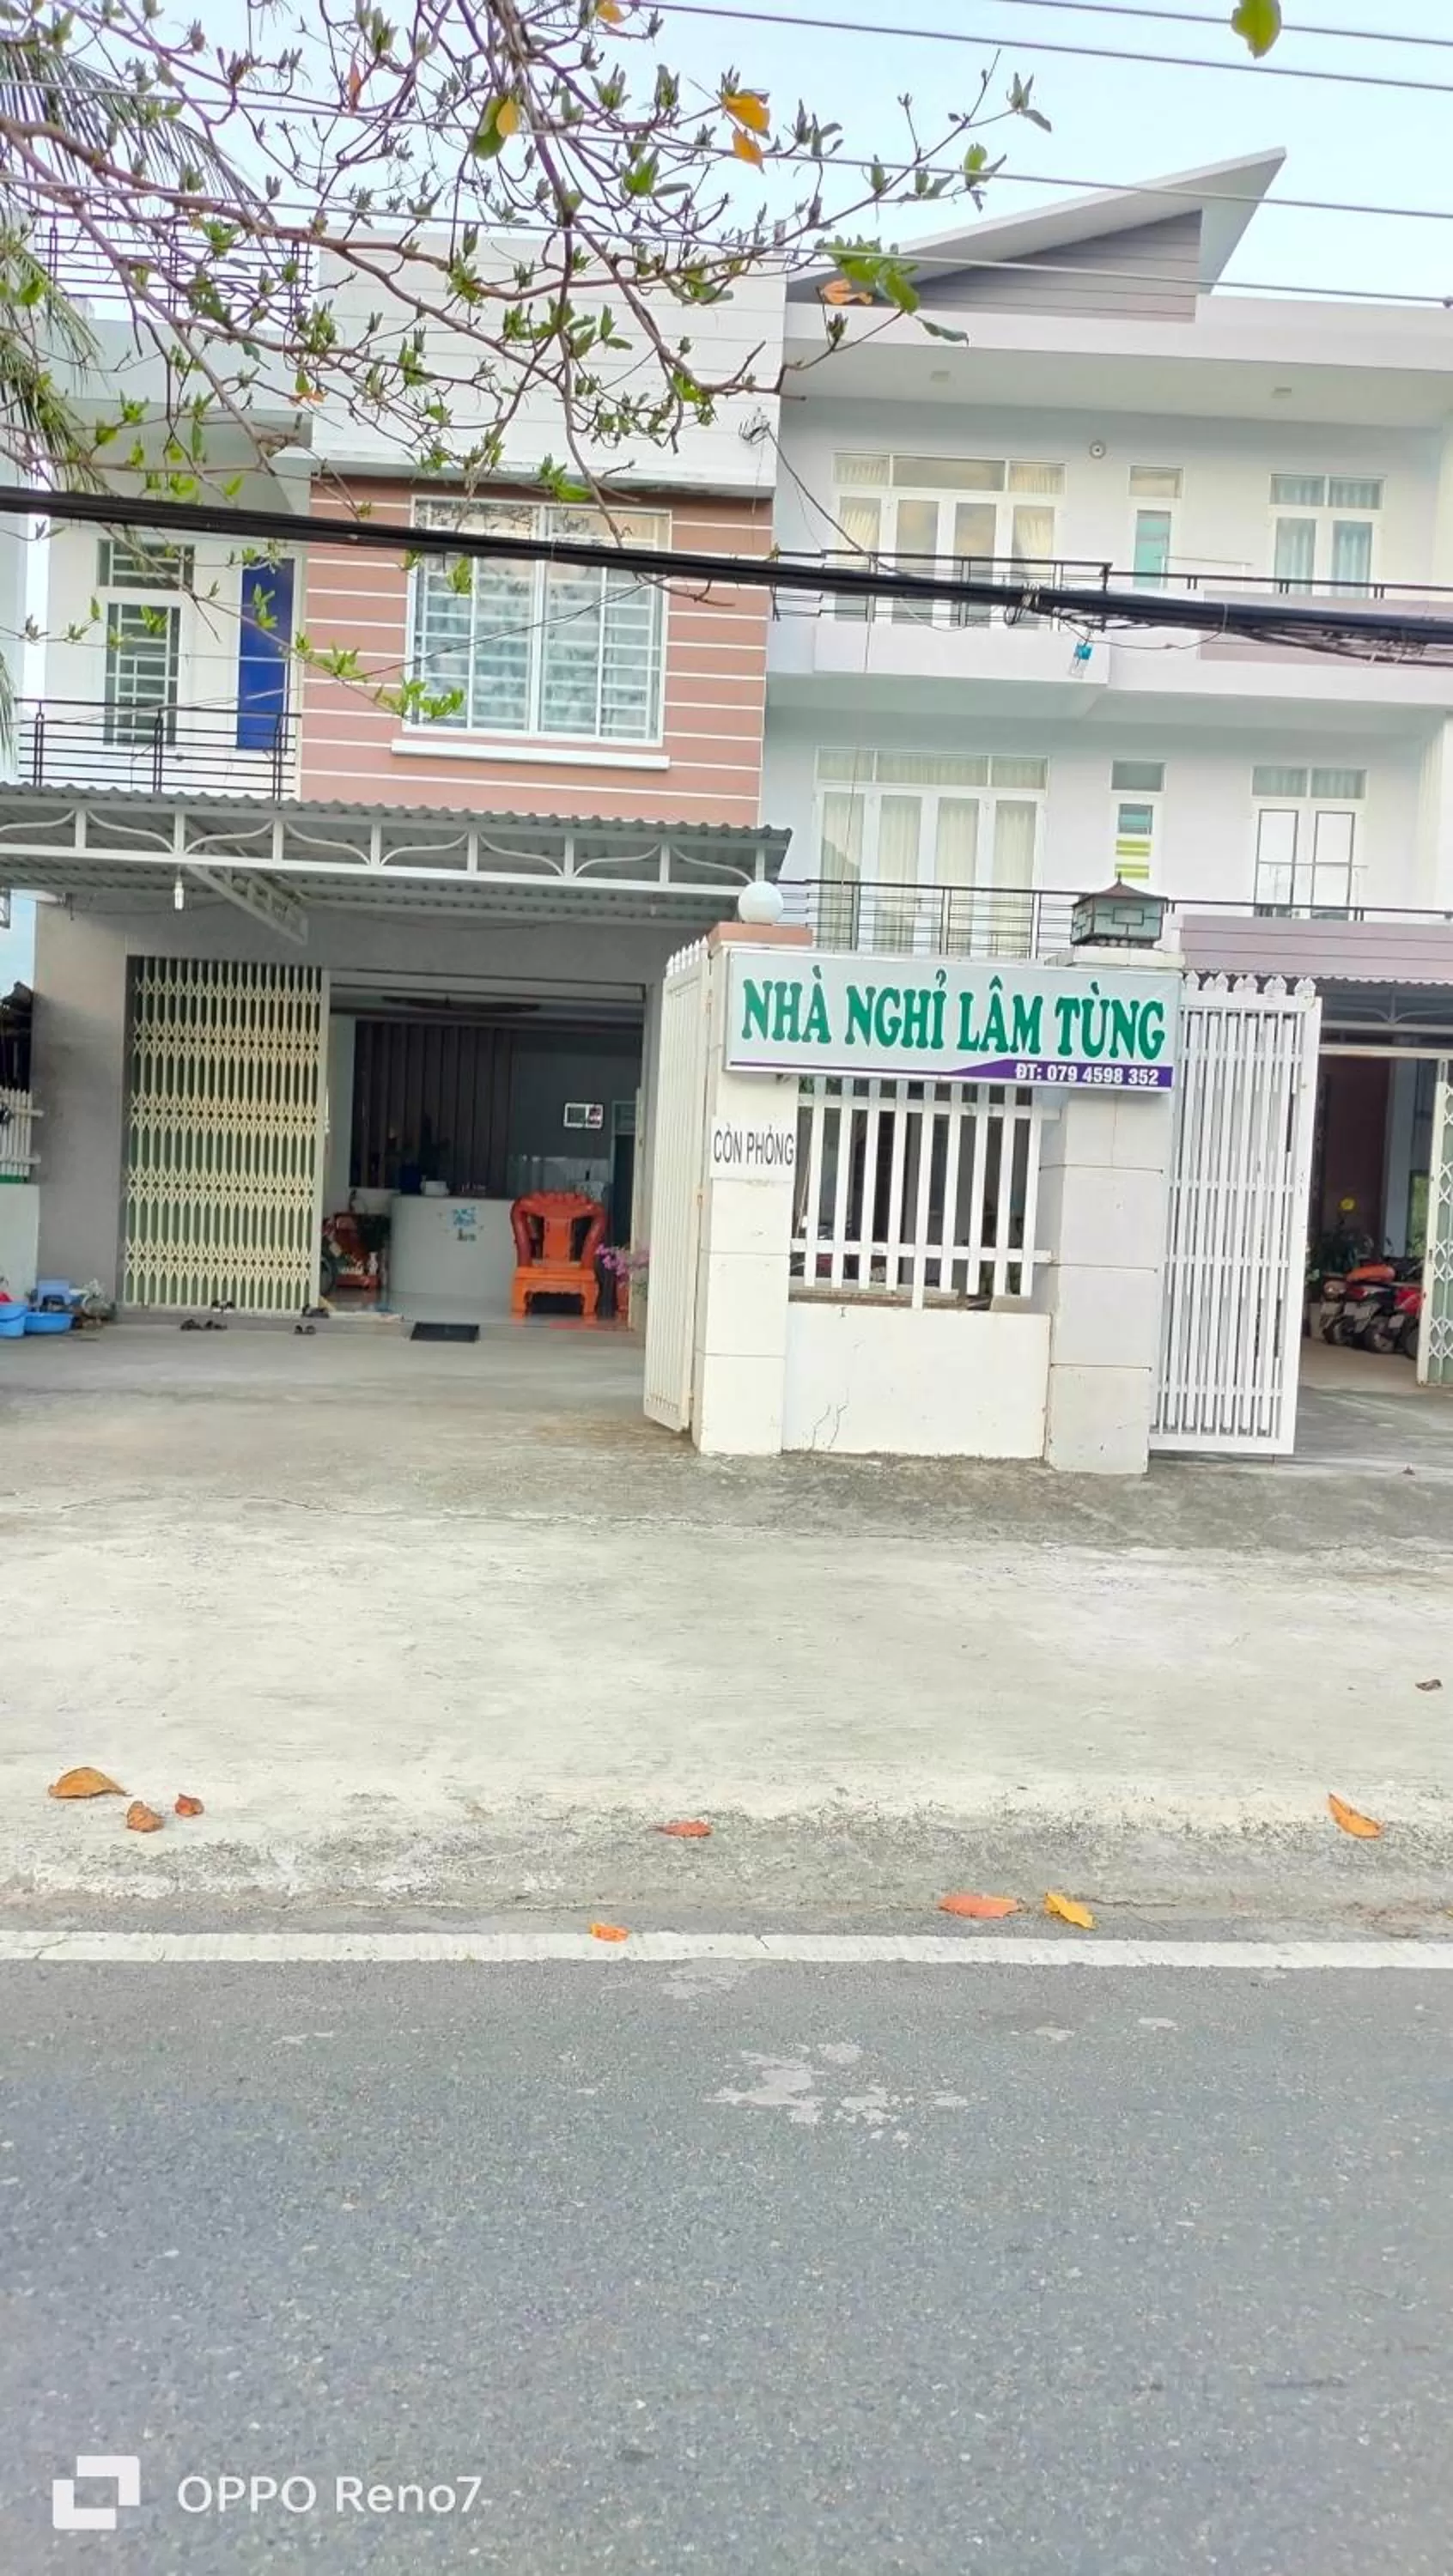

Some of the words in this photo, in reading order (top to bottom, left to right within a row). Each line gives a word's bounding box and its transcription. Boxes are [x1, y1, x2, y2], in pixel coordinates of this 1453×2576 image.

[742, 964, 832, 1044] NHÀ
[844, 968, 947, 1050] NGHỈ
[957, 975, 1043, 1055] LÂM
[1055, 981, 1165, 1060] TÙNG
[1015, 1062, 1042, 1080] ĐT:
[1047, 1064, 1078, 1083] 079
[1082, 1066, 1123, 1084] 4598
[1128, 1067, 1158, 1085] 352
[714, 1121, 743, 1163] CÒN
